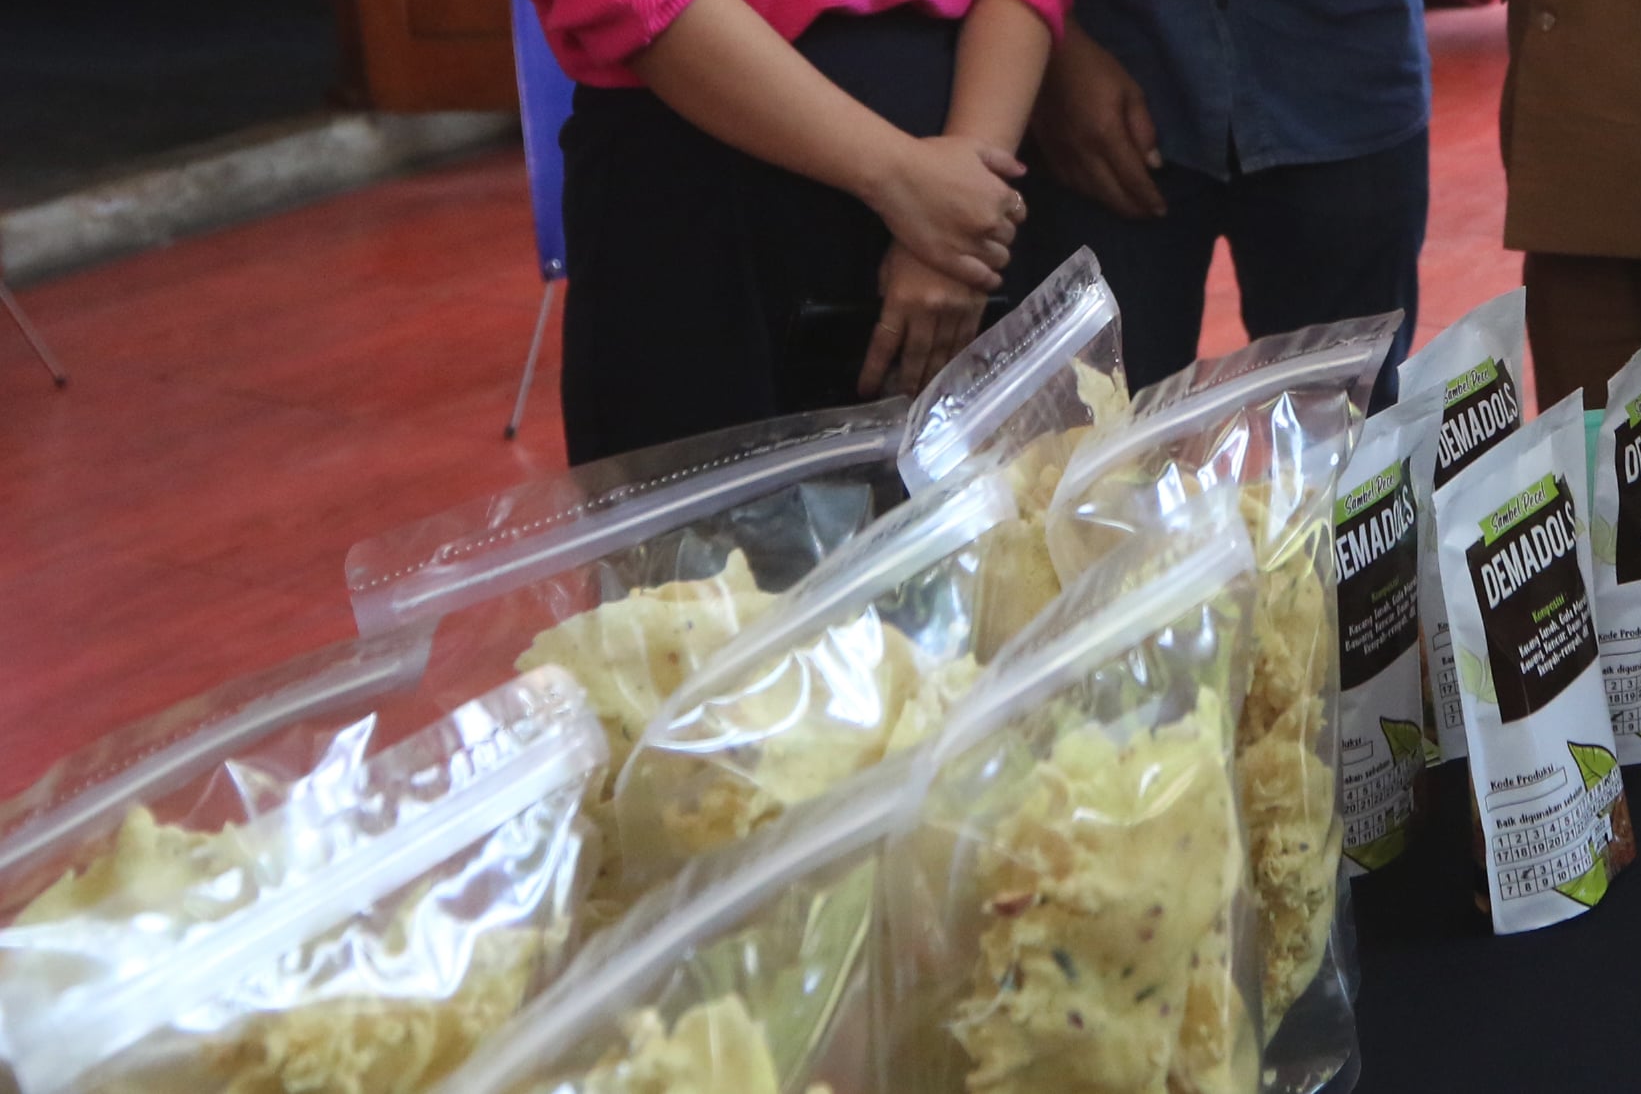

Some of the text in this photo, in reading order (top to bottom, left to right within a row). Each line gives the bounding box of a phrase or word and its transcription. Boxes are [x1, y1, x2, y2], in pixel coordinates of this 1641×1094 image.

[1345, 477, 1374, 516] Sambel
[1490, 482, 1546, 534] Sambel Pecel
[1480, 500, 1577, 610] DEMADOLS
[1608, 693, 1621, 704] 18
[1624, 691, 1636, 703] 19
[1490, 764, 1555, 792] Kode Produksi
[1496, 817, 1516, 829] Baik
[1519, 802, 1563, 824] digunakan
[1496, 850, 1510, 863] 17
[1515, 846, 1528, 859] 18
[1532, 841, 1546, 855] 19
[1549, 836, 1561, 849] 20
[1565, 828, 1575, 842] 21
[1515, 832, 1523, 844] 2
[1525, 880, 1533, 892] 8
[1541, 876, 1549, 888] 9
[1556, 869, 1568, 882] 10
[1573, 862, 1581, 874] 11
